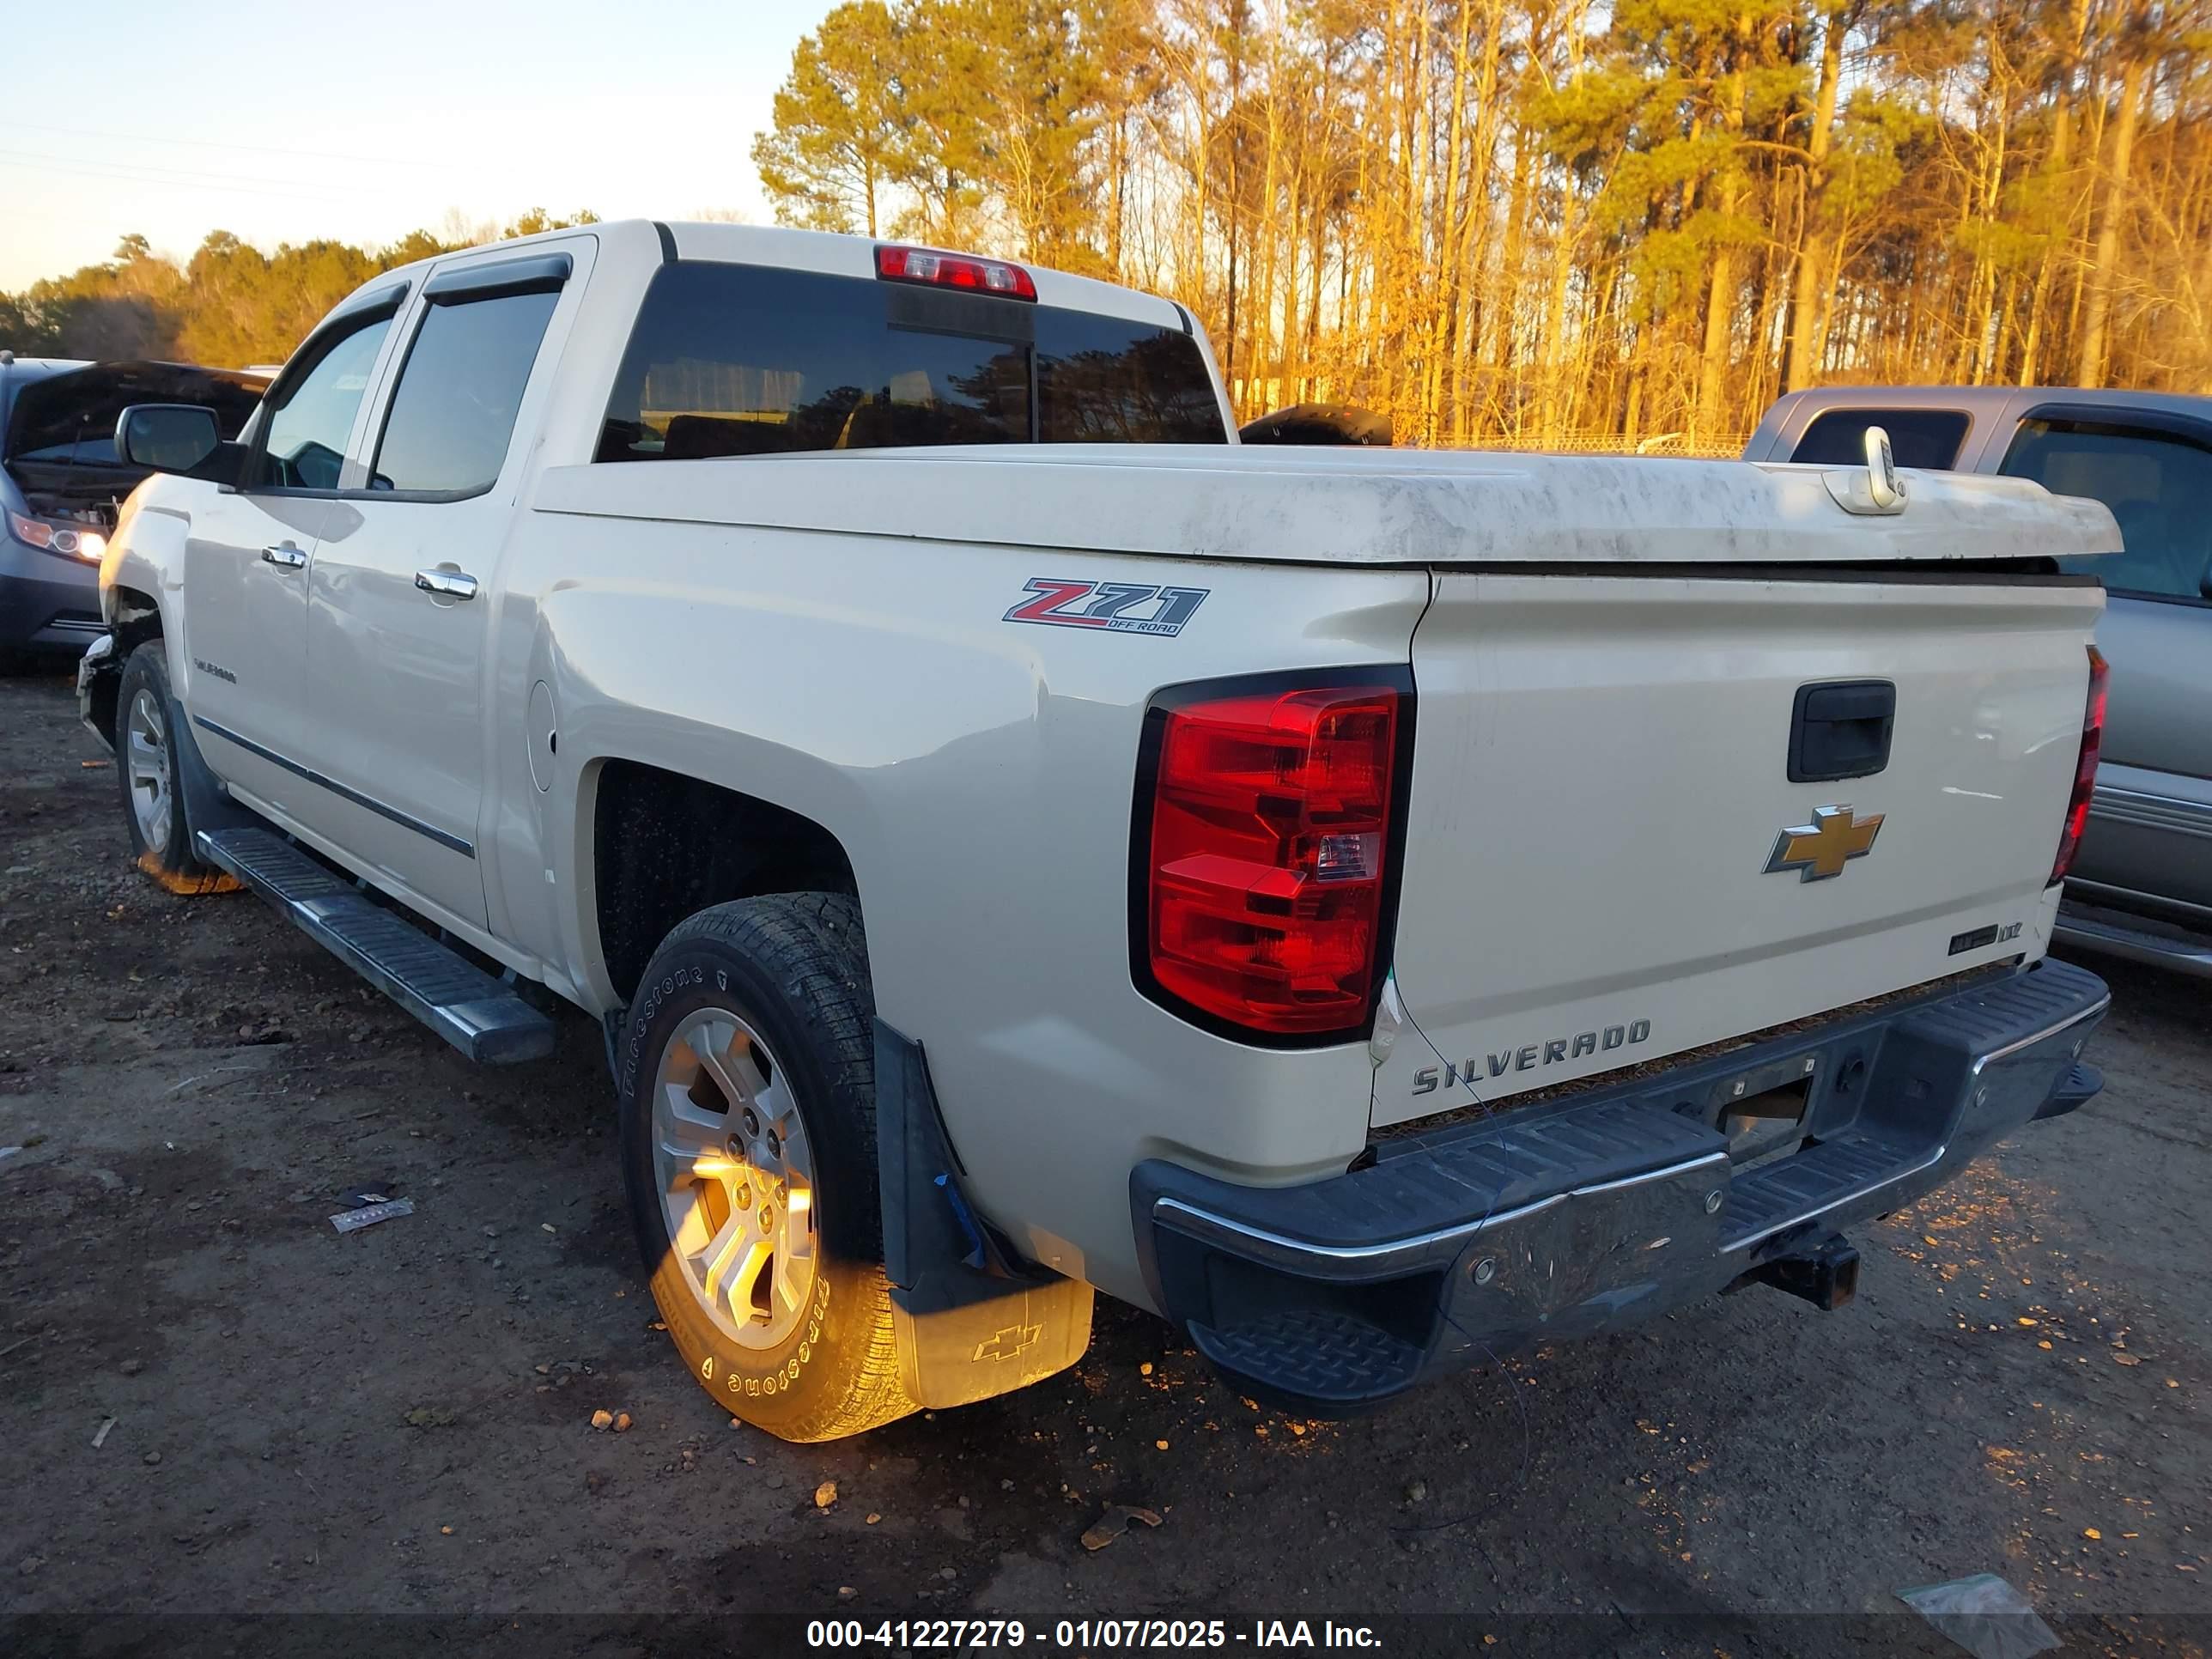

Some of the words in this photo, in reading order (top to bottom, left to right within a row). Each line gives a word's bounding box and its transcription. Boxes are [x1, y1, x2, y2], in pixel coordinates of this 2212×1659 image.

[1001, 576, 1212, 638] Z71
[1108, 620, 1135, 630] OFF
[1136, 623, 1179, 634] ROAD
[1412, 1017, 1652, 1096] SILVERADO
